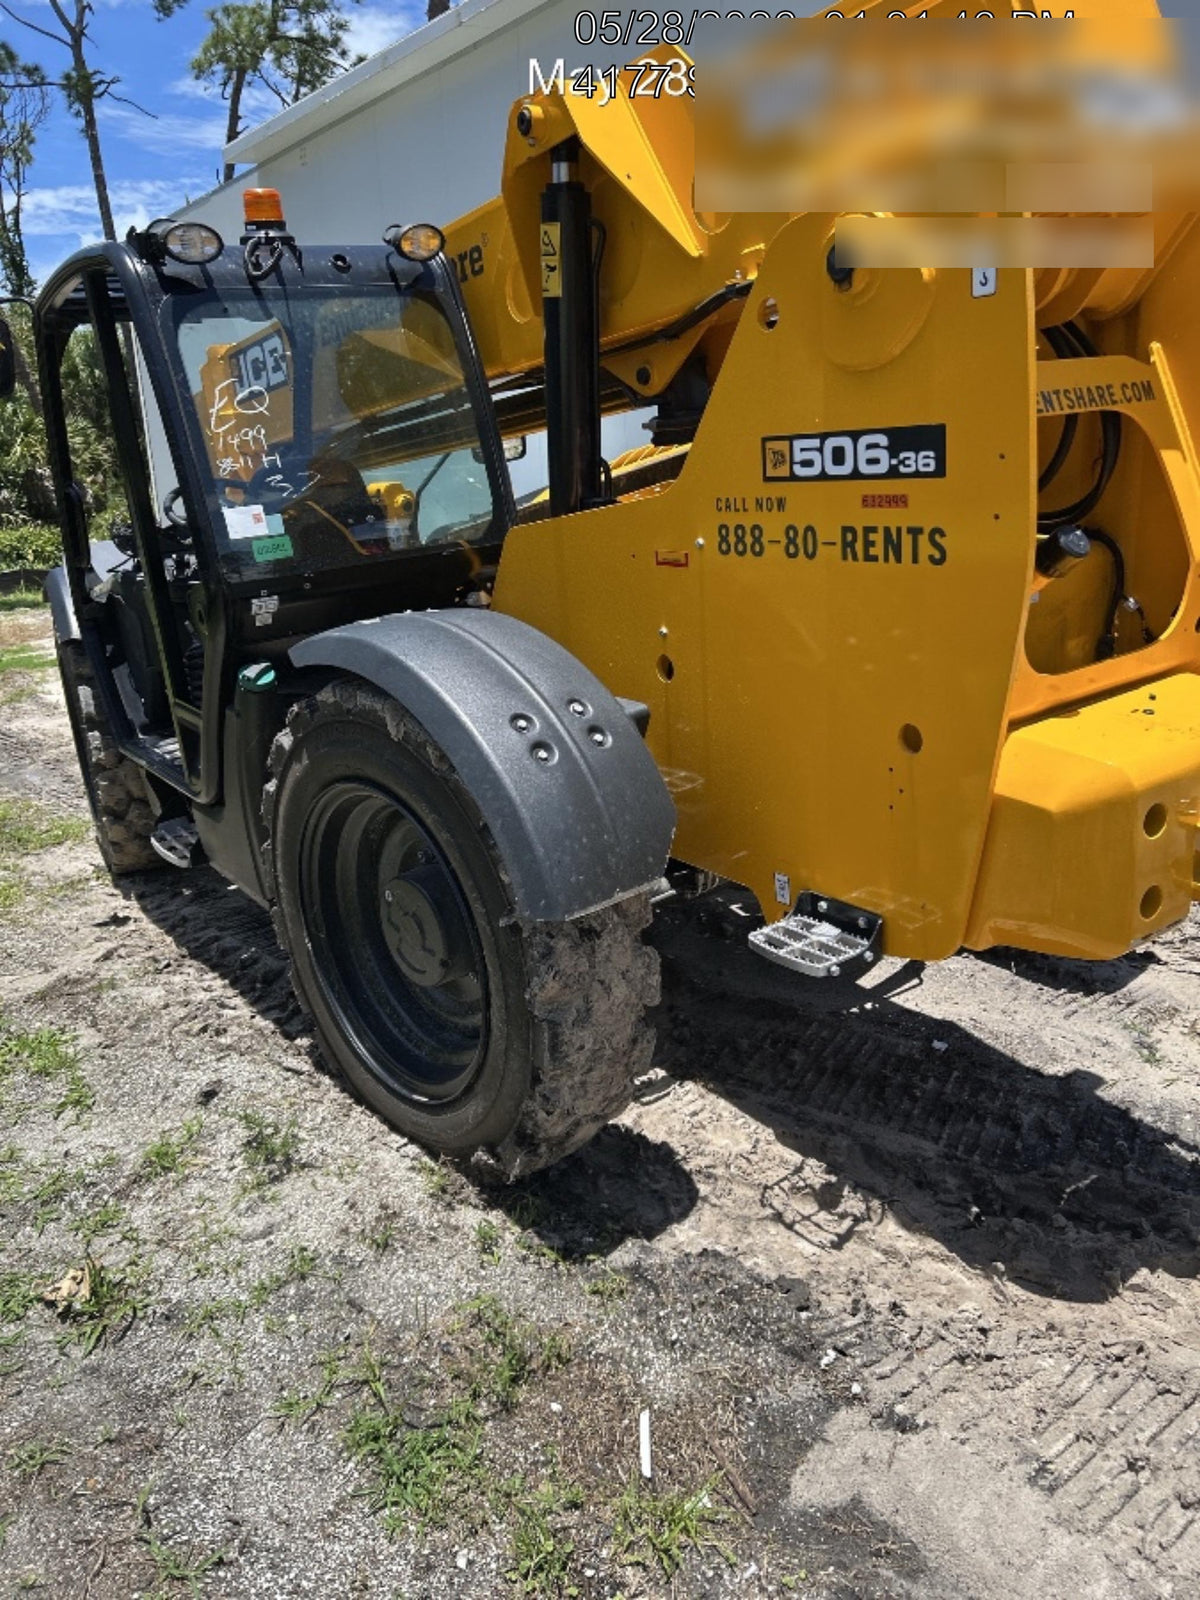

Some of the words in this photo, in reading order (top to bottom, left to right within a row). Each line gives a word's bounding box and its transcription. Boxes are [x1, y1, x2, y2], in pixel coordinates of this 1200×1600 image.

[792, 433, 936, 477] 506-36
[715, 496, 749, 512] CALL
[755, 496, 787, 512] NOW
[717, 523, 948, 566] 888-80-RENTS
